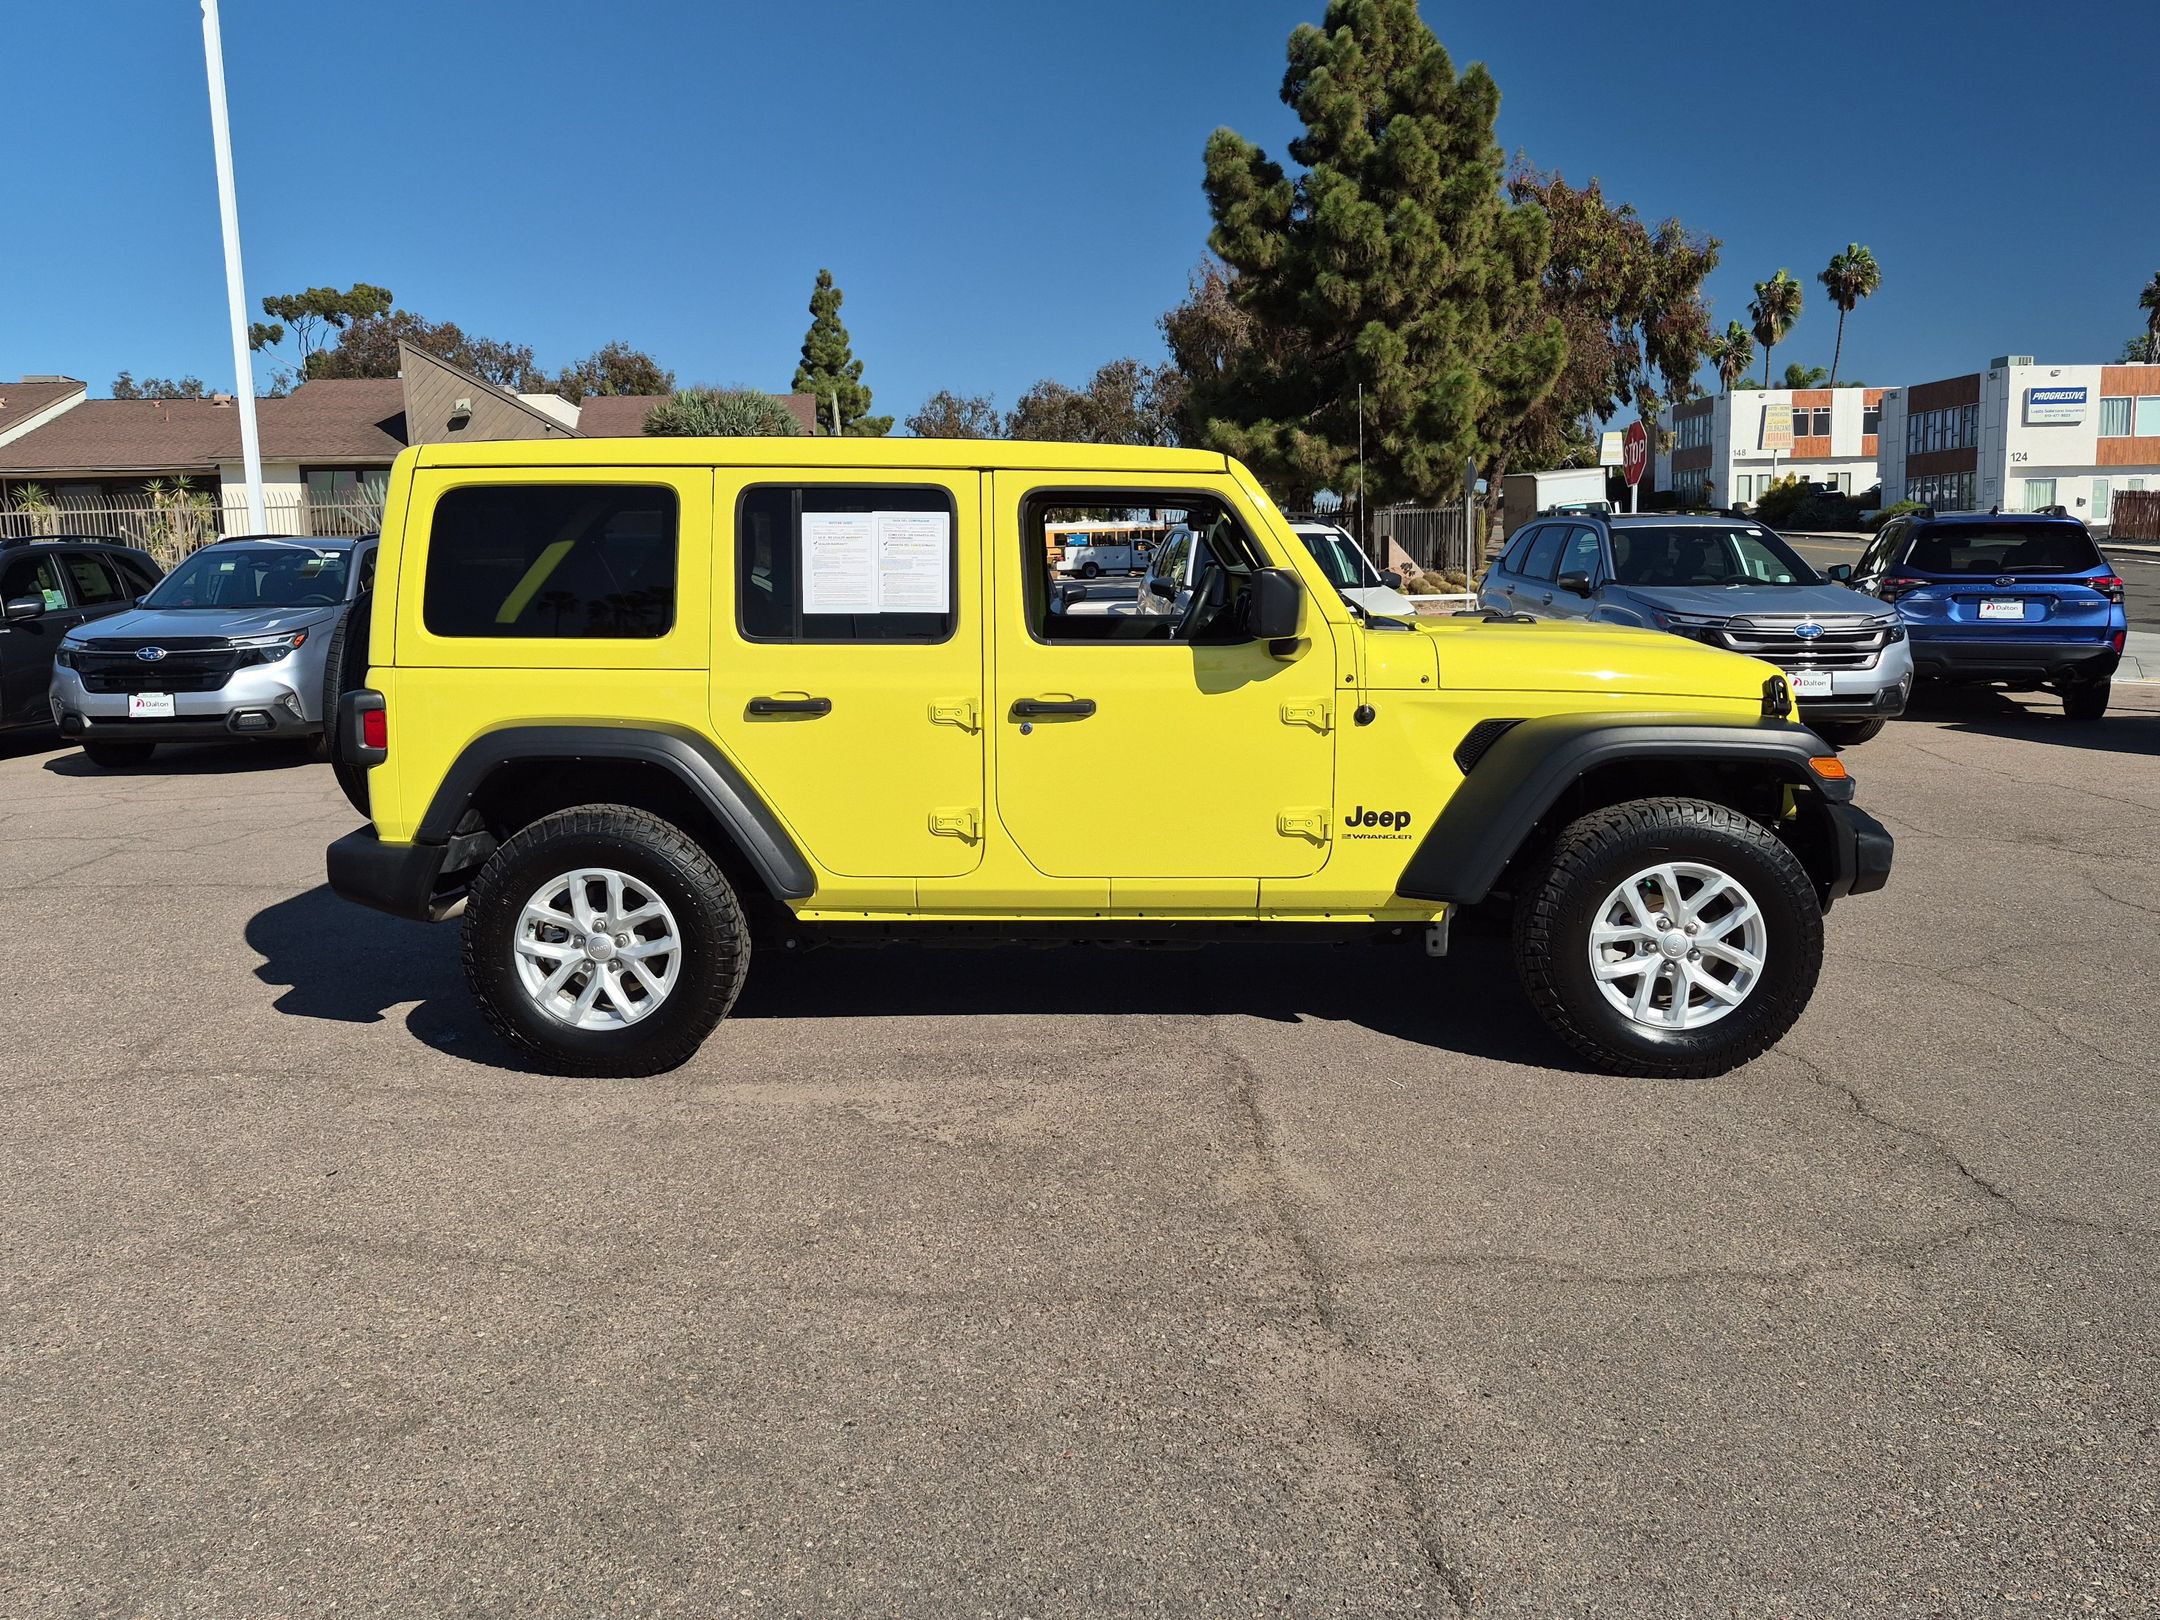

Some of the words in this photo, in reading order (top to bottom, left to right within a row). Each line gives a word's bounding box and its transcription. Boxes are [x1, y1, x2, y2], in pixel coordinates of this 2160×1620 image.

[2032, 391, 2085, 400] PROGRESSIVE
[1624, 438, 1645, 468] STOP
[1733, 449, 1747, 457] 148
[2010, 451, 2028, 462] 124
[1345, 806, 1411, 831] Jeep
